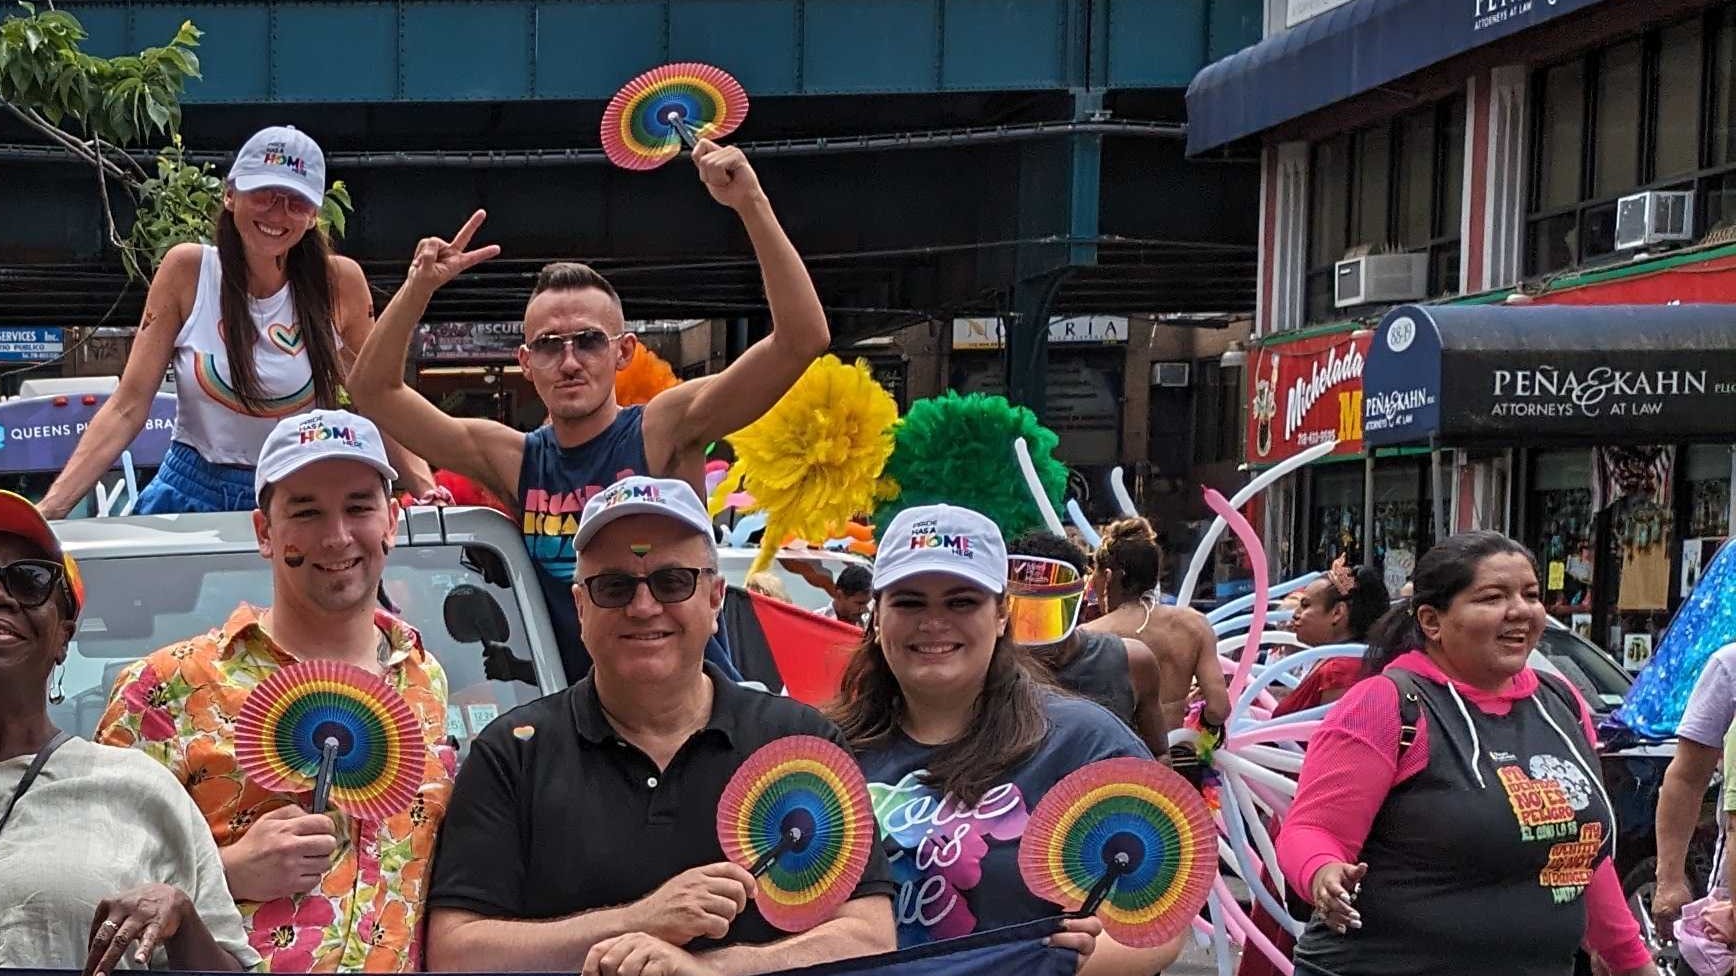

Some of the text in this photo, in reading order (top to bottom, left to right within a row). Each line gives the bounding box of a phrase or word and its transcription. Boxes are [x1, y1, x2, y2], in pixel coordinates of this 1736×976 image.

[44, 332, 60, 342] Inc.
[1491, 402, 1663, 417] ATTORNEYS AT LAW
[11, 424, 72, 440] QUEENS
[300, 427, 358, 445] HOME
[910, 535, 974, 550] HOME
[1514, 789, 1567, 811] NO ES
[1520, 806, 1575, 824] PELIGRO
